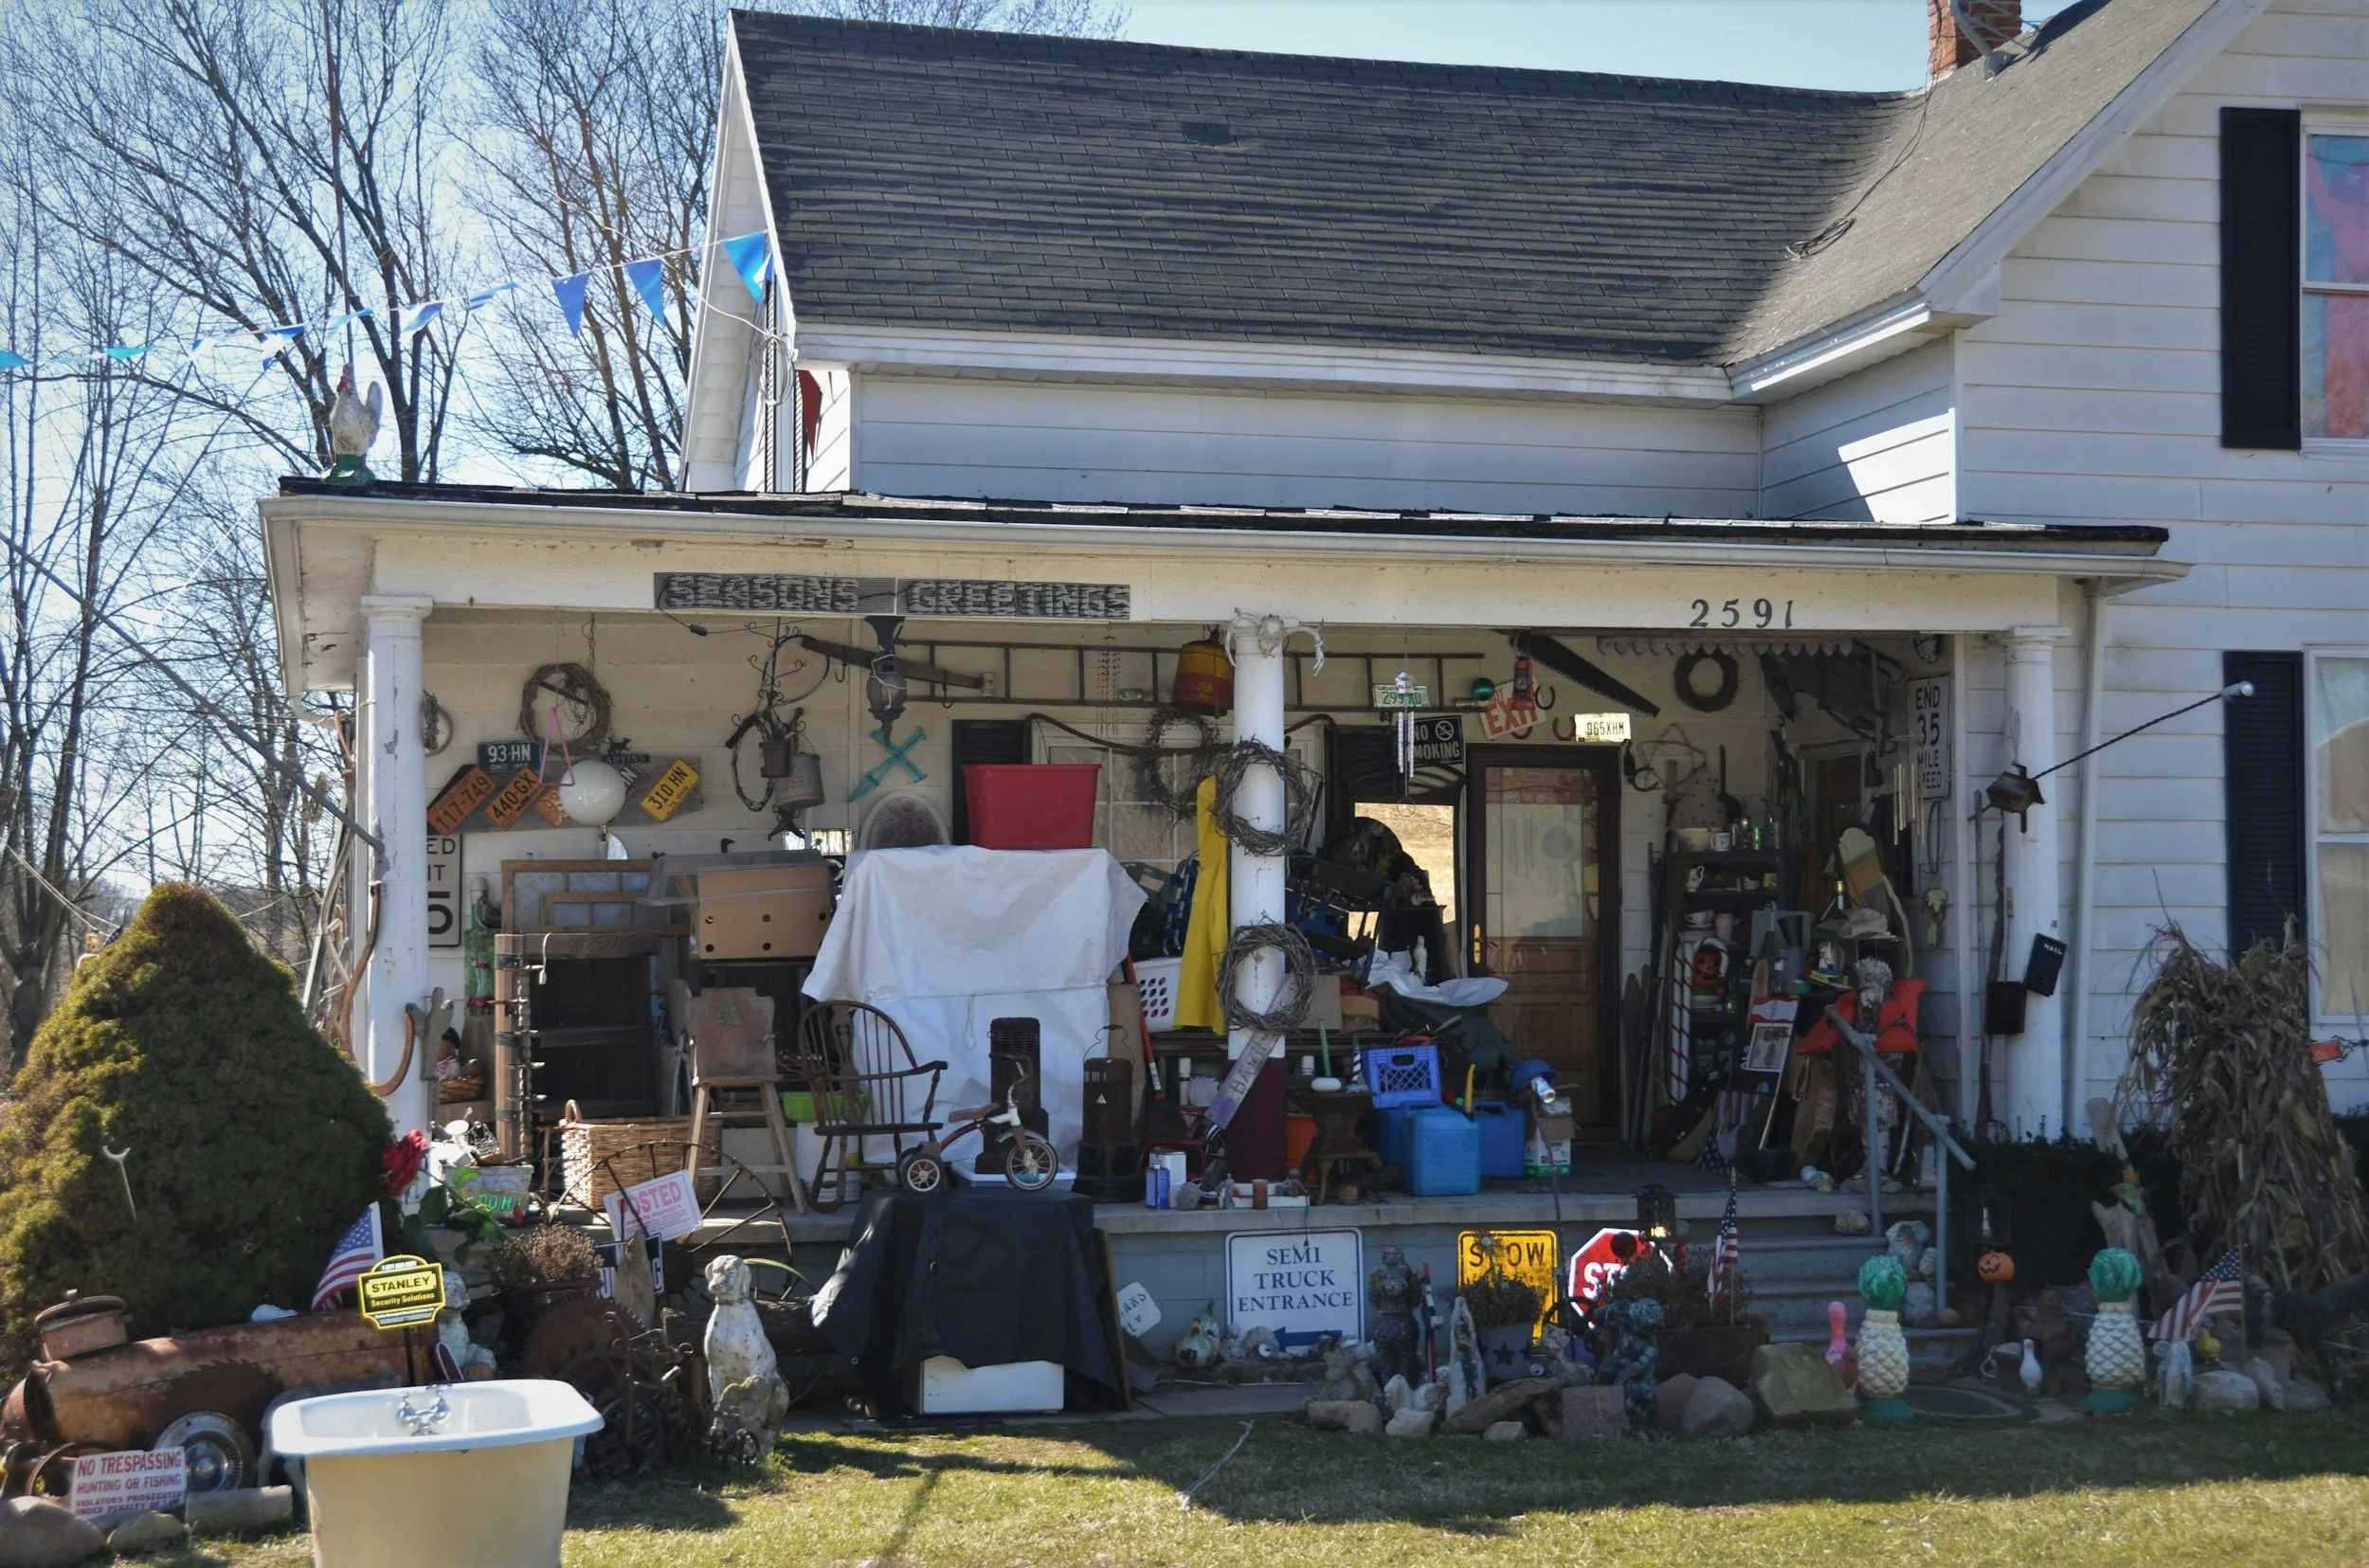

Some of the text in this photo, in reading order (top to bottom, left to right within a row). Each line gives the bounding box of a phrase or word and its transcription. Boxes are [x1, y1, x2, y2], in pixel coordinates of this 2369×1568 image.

[668, 574, 1130, 620] SEASONS GREETINGS
[1690, 598, 1793, 628] 2591
[1916, 685, 1941, 711] END
[1586, 721, 1625, 736] 965XHM
[1917, 712, 1940, 748] 35
[1415, 741, 1460, 760] MOKING
[1917, 750, 1940, 768] MILE
[648, 766, 689, 810] 310 HN
[1919, 770, 1942, 790] PEED
[1266, 1245, 1322, 1266] SEMI
[1470, 1242, 1545, 1268] SOW
[371, 1275, 430, 1293] STANLEY
[1254, 1270, 1335, 1289] TRUCK
[371, 1292, 435, 1307] Security Solutions
[1238, 1291, 1354, 1312] ENTRANCE
[78, 1451, 182, 1477] NO TRESPASSING
[77, 1473, 182, 1495] HUNTING OR FISHING
[76, 1496, 123, 1507] VIOLATORS
